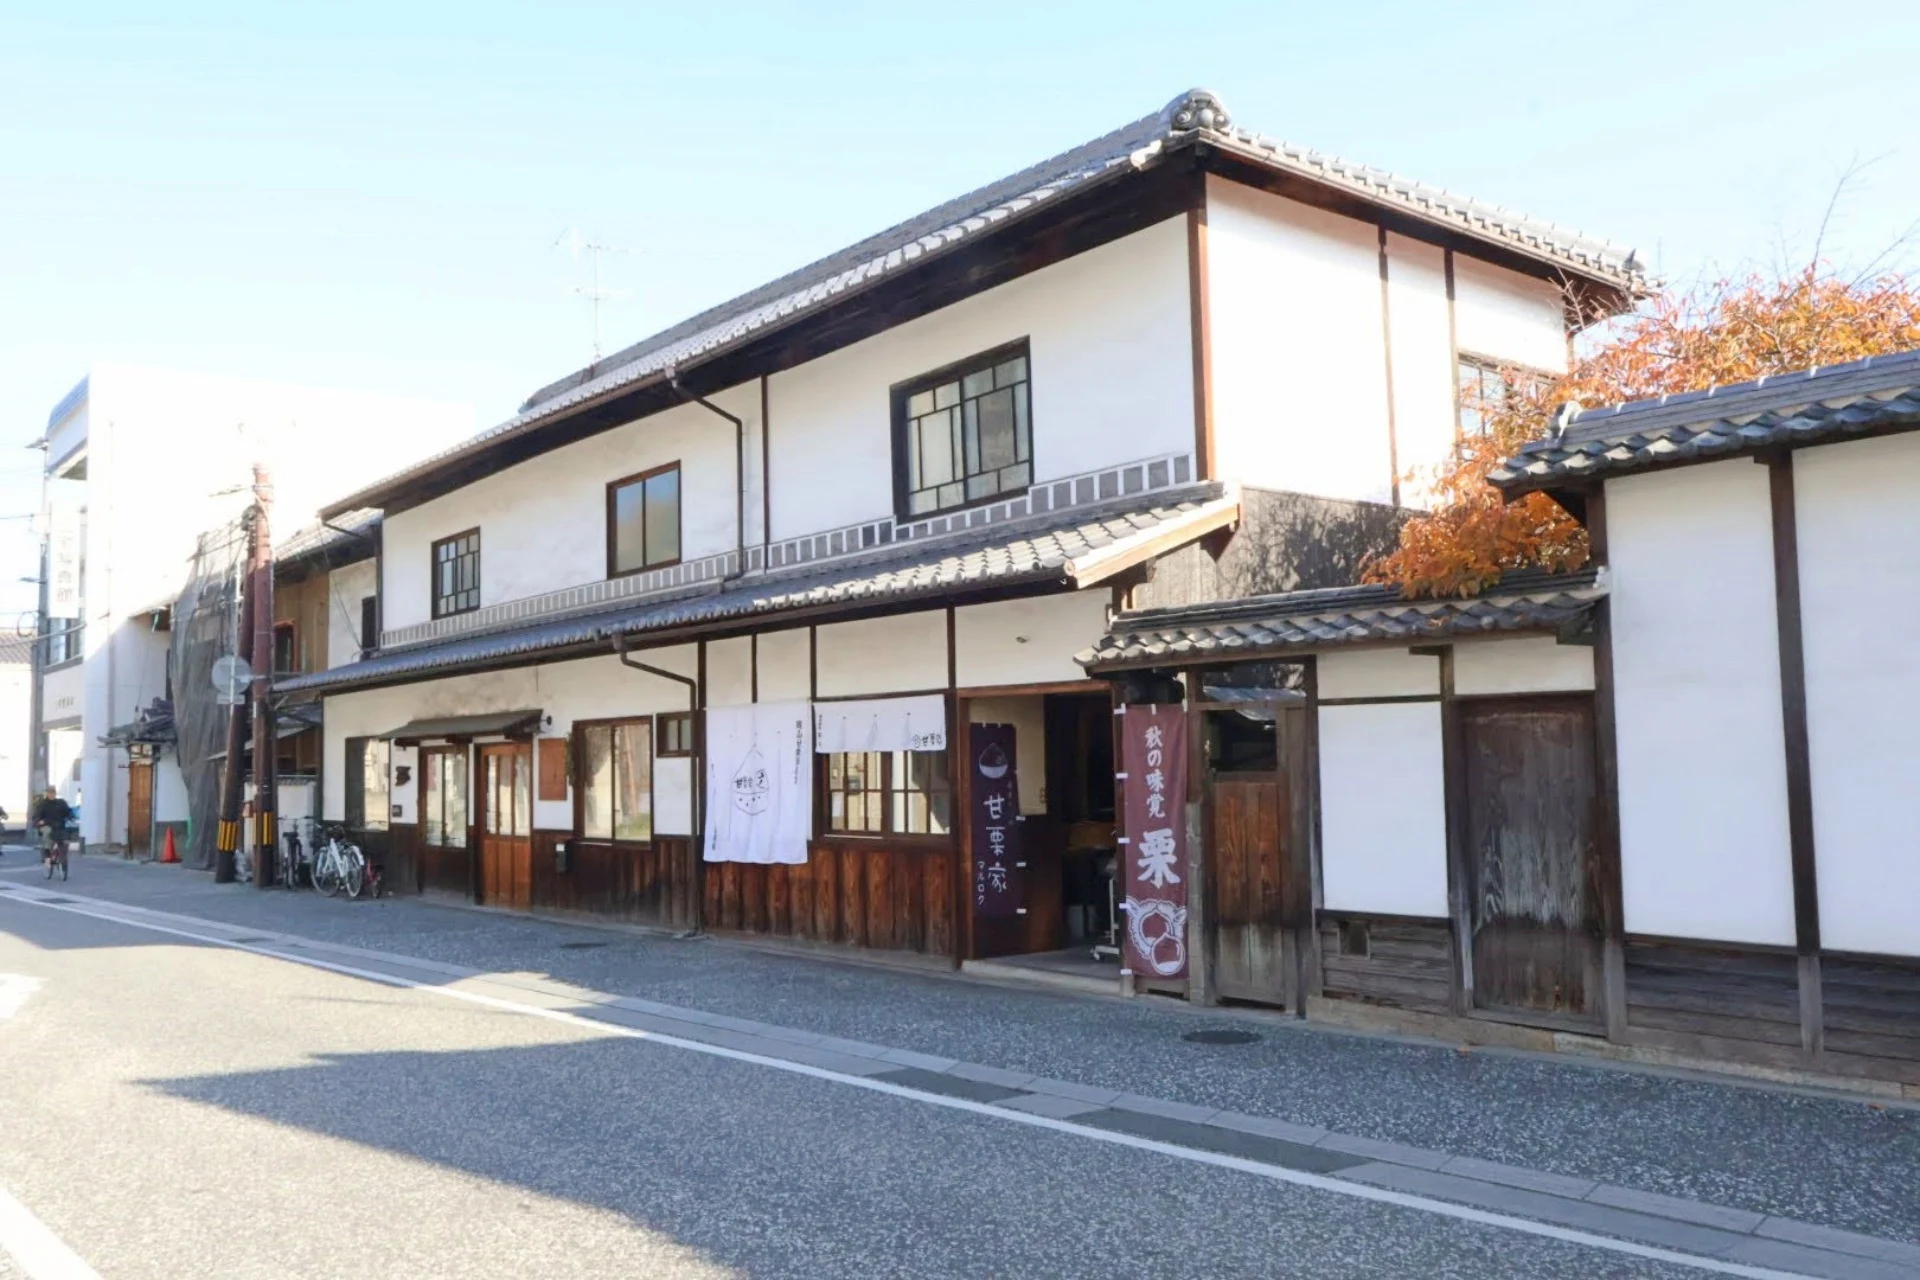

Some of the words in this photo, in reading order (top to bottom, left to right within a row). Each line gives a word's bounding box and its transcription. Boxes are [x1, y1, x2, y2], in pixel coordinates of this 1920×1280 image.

[1144, 726, 1166, 819] 秋の味覚
[1137, 828, 1181, 890] 栗
